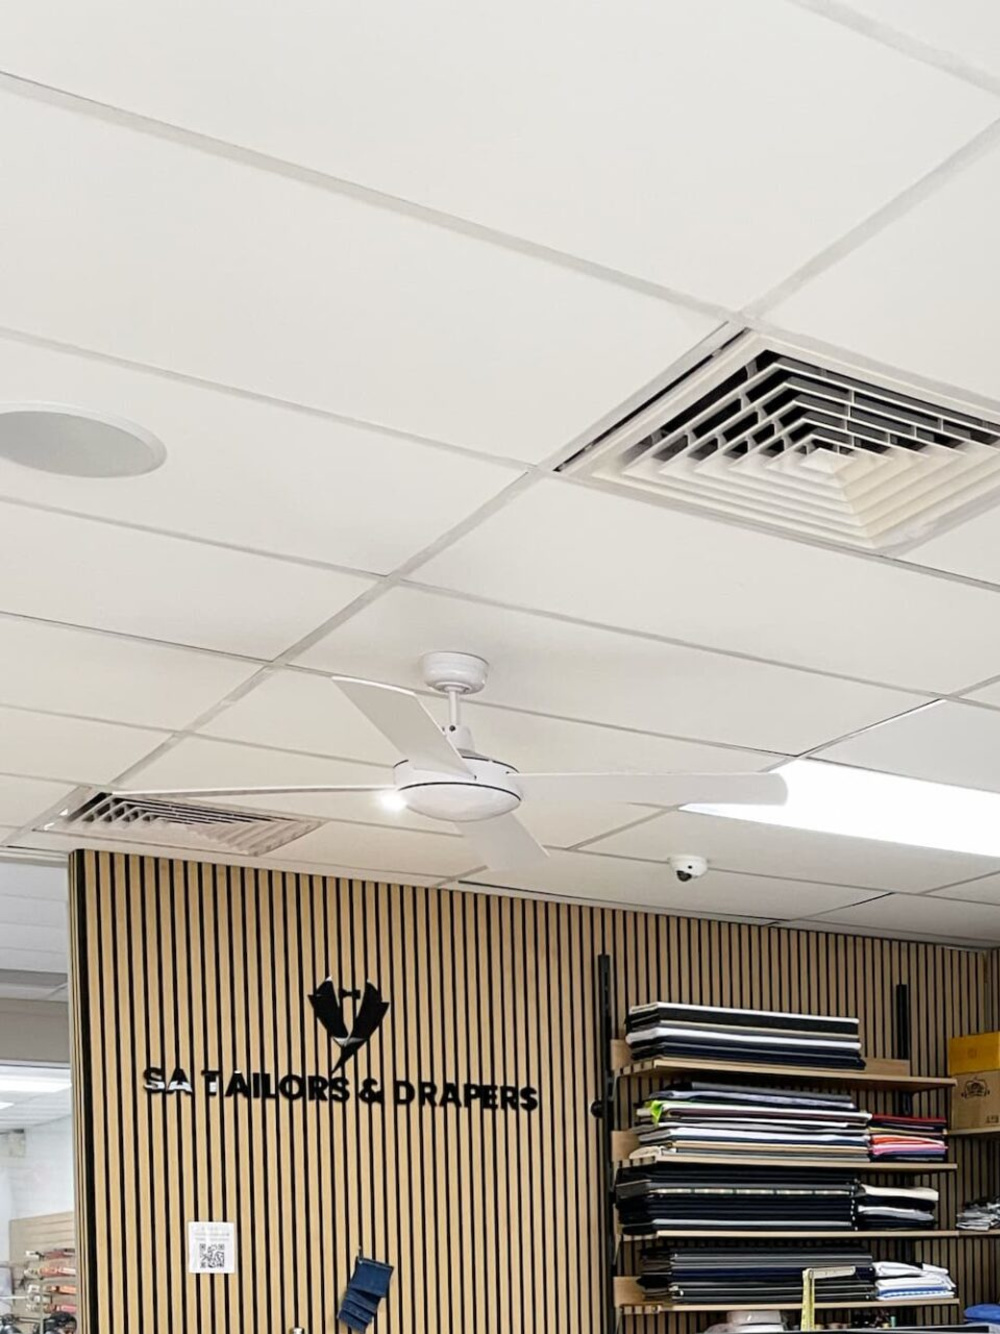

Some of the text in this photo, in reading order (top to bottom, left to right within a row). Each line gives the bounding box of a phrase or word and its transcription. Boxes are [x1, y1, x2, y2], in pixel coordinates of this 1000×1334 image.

[143, 1067, 539, 1112] SA TAILORS & DRAPERS
